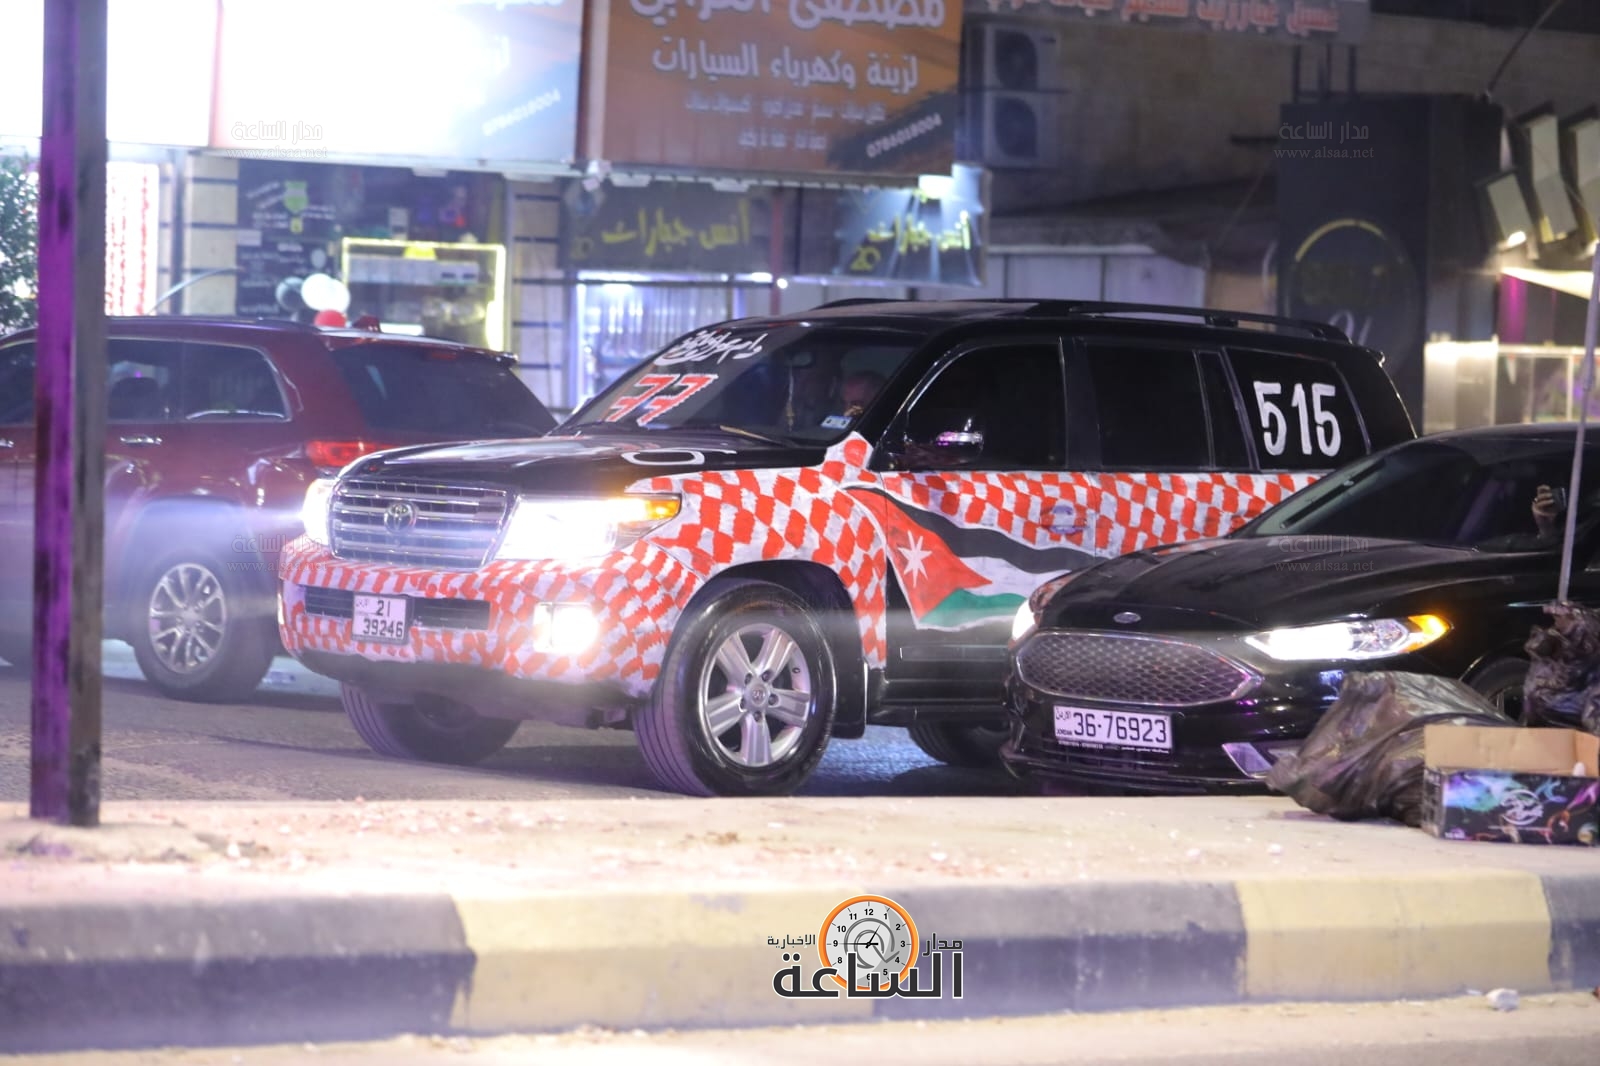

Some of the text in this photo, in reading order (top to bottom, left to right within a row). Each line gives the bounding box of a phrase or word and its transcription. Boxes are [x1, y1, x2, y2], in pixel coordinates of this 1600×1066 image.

[652, 37, 759, 80] السيارات
[770, 46, 858, 89] وكهرباء
[1253, 381, 1341, 457] 515
[362, 618, 404, 638] 39246
[375, 600, 391, 617] 21
